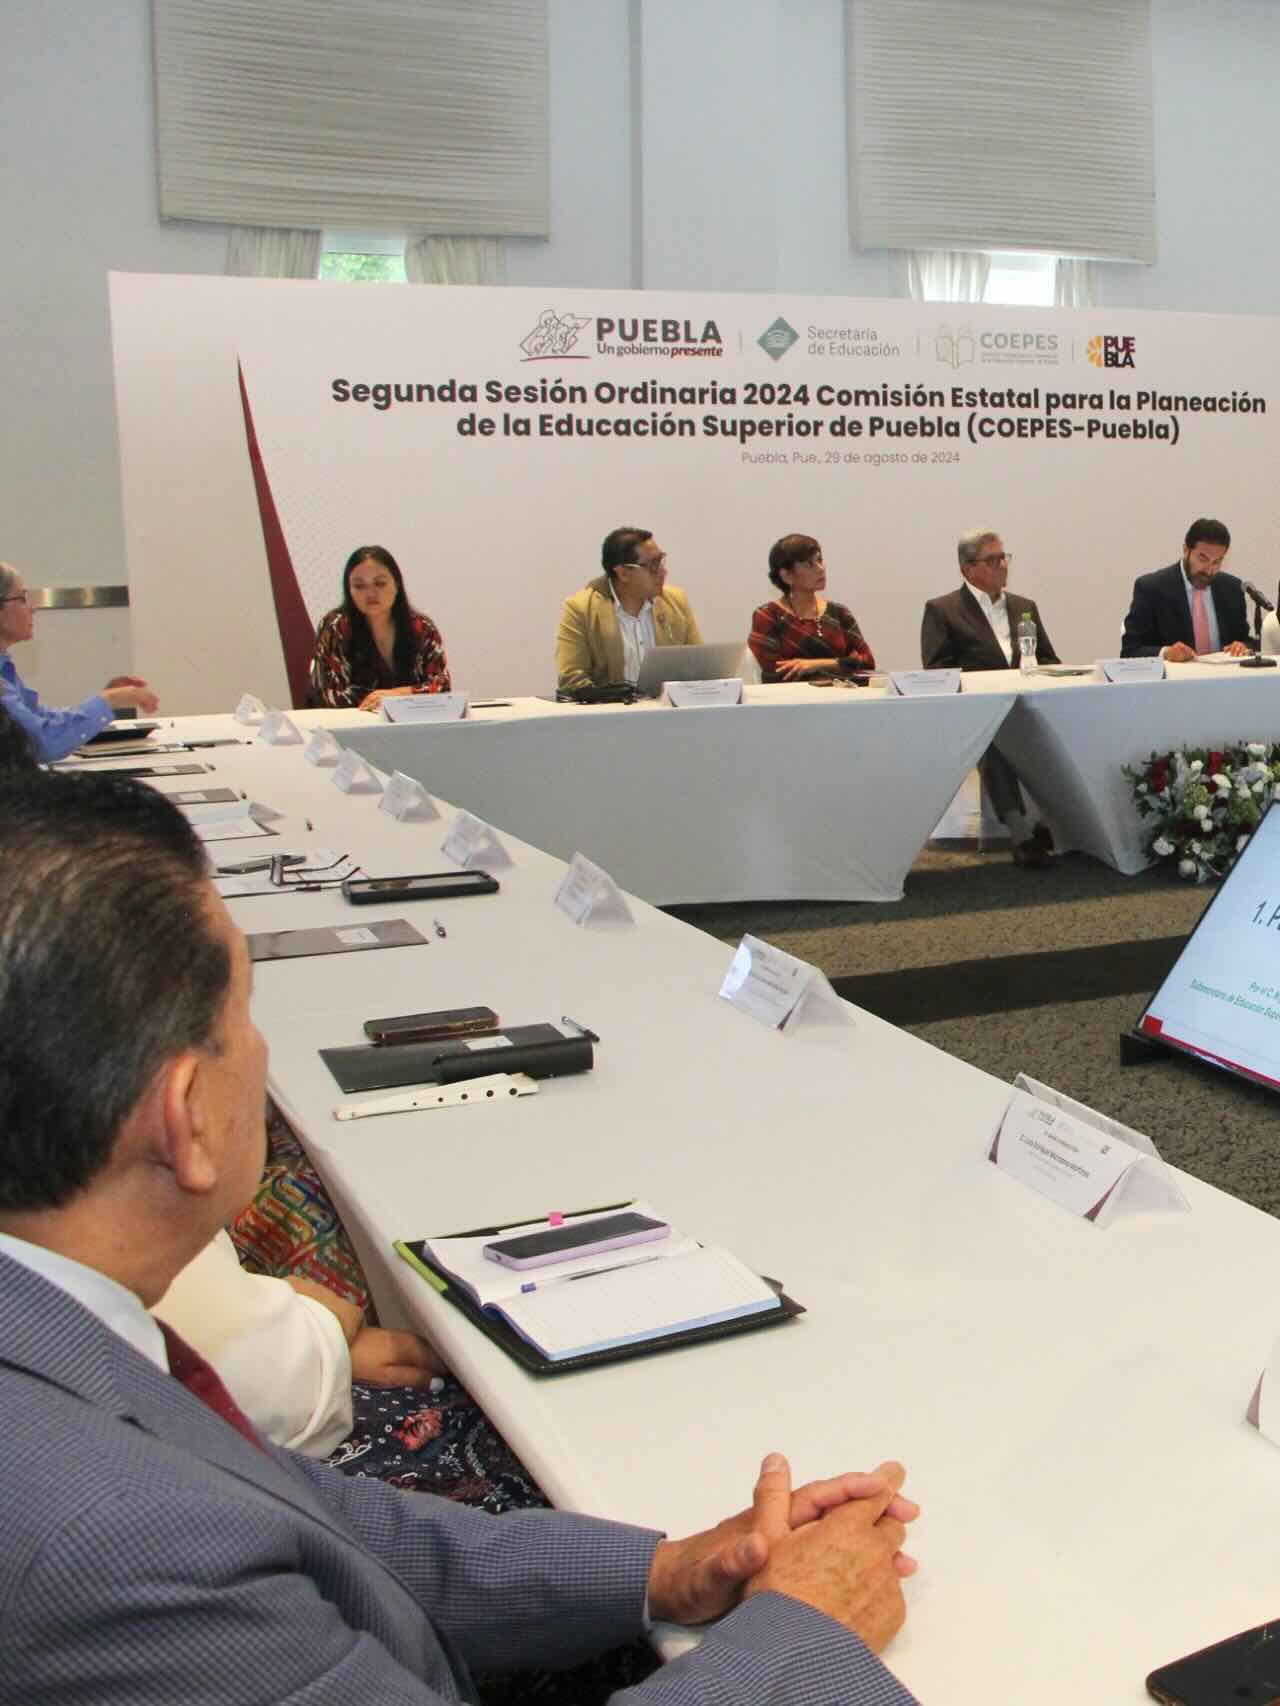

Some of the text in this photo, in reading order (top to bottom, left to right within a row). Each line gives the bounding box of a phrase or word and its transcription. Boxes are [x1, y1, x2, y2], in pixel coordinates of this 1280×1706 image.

[596, 318, 722, 343] PUEBLA
[807, 325, 878, 342] Secretaría
[807, 342, 900, 358] de Educación
[980, 333, 1059, 350] COEPES
[1103, 335, 1136, 352] PUE
[597, 343, 723, 358] Un gobierno presente
[1103, 351, 1136, 368] BLA
[331, 377, 1266, 416] Segunda Sesión Ordinaria 2024 Comisión Estatal para la Planeación
[456, 412, 1181, 445] de la Educación Superior de Puebla (COEPES-Puebla)
[741, 451, 788, 465] Puebla,
[843, 451, 861, 465] de
[863, 452, 908, 467] agosto
[911, 451, 928, 465] de
[930, 452, 961, 465] 2024
[1251, 899, 1268, 925] 1.
